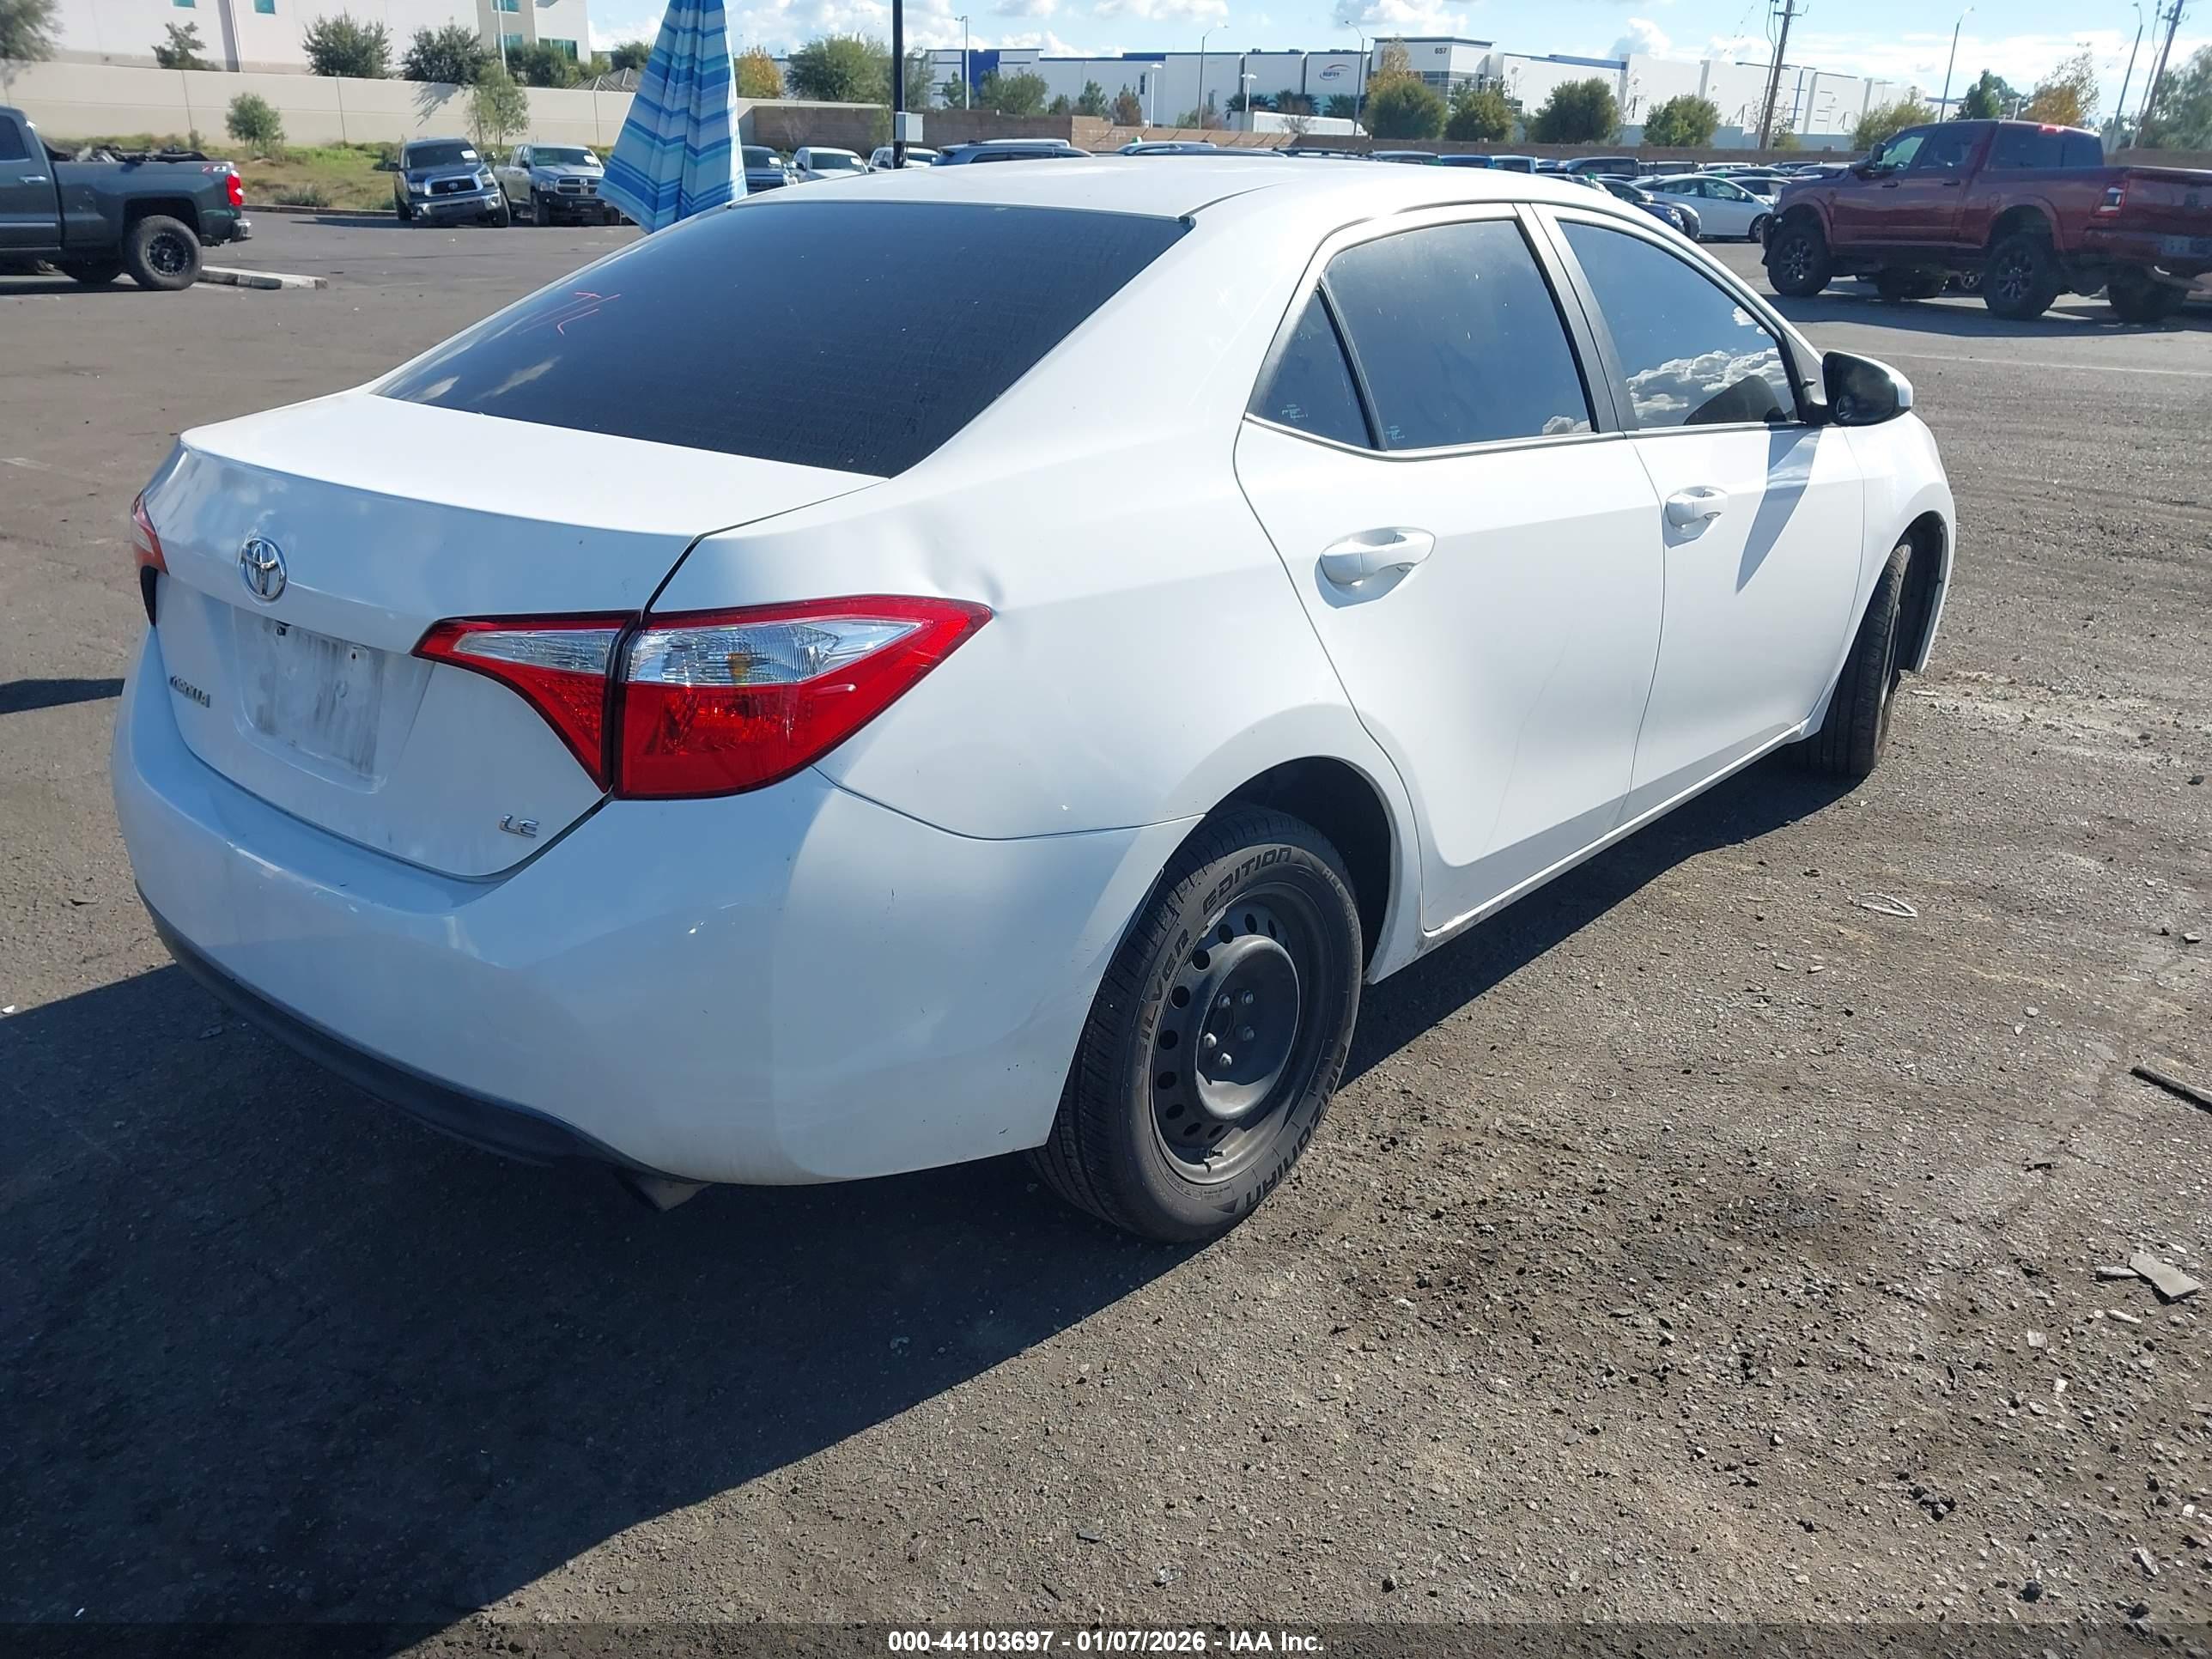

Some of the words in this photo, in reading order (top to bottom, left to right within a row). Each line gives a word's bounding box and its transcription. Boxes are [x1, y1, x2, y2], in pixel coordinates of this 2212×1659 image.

[499, 813, 540, 839] LE
[1136, 927, 1190, 1069] SILVER
[1202, 846, 1293, 915] EDITION
